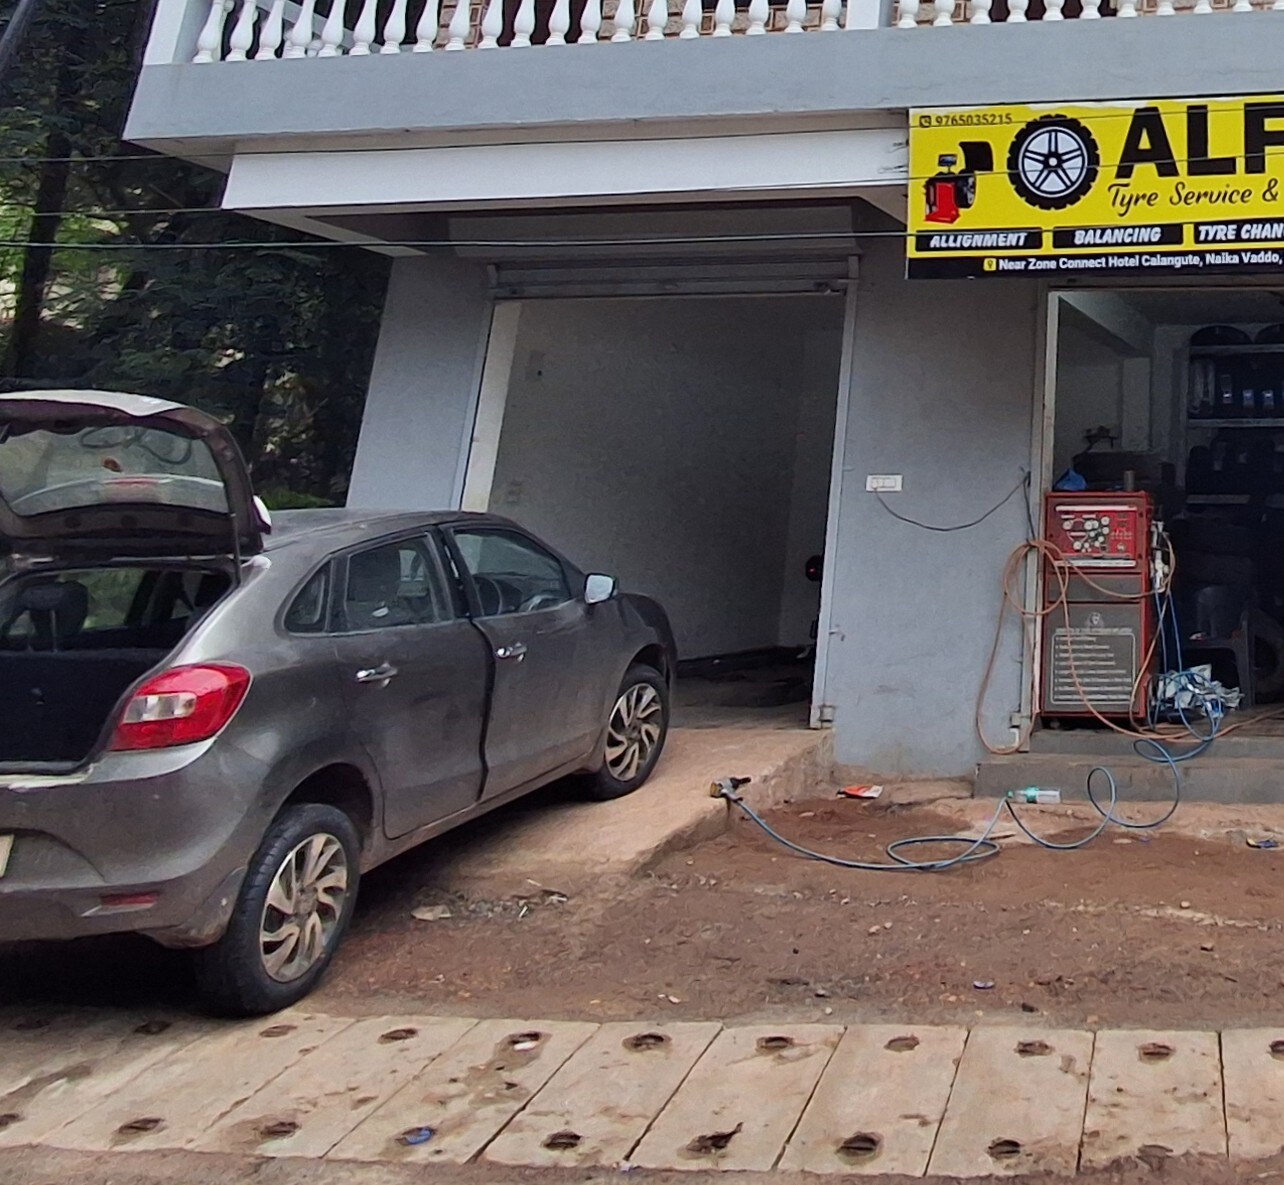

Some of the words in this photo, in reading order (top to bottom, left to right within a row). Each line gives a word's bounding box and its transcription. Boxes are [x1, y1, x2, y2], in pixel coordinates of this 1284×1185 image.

[935, 113, 1013, 126] 9765035215
[1107, 182, 1159, 217] Tyre
[1169, 180, 1252, 205] Service
[1262, 178, 1278, 202] &
[930, 232, 1027, 248] ALLIGNMENT
[1074, 227, 1161, 245] BALANCING
[1198, 224, 1236, 240] TYRE
[998, 259, 1026, 270] Near
[1027, 258, 1057, 270] Zone
[1059, 256, 1106, 269] Connect
[1108, 255, 1139, 267] Hotel
[1142, 252, 1203, 268] Calangute,
[1205, 252, 1239, 264] Naika
[1242, 251, 1283, 265] Vaddo,
